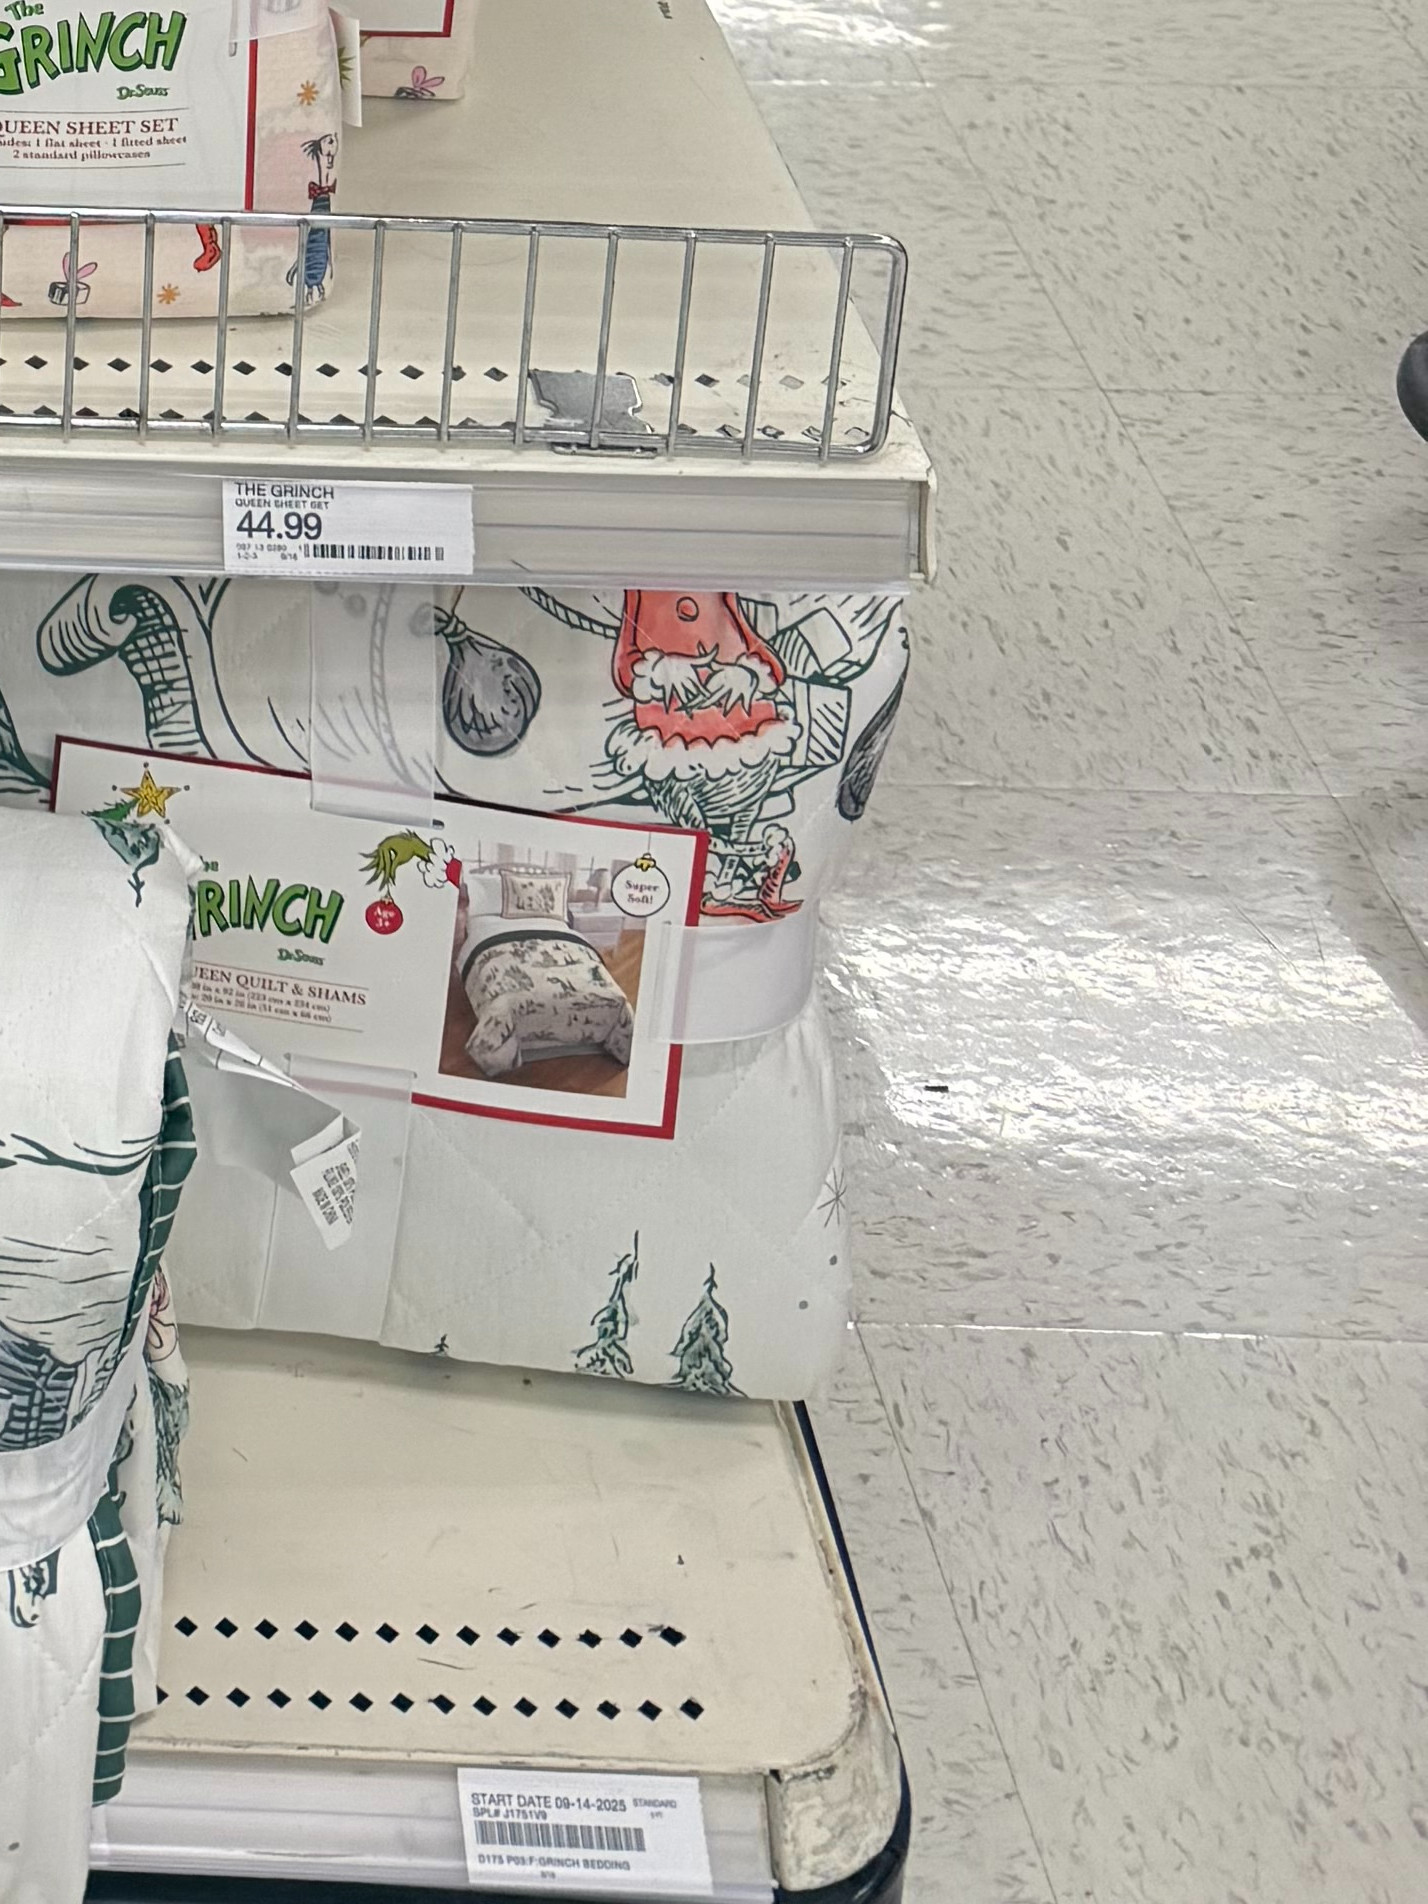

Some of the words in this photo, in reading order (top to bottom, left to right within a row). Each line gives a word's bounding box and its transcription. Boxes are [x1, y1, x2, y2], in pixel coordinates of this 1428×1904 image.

[4, 0, 44, 21] The
[66, 121, 135, 134] SHEET
[140, 118, 178, 133] SET
[69, 138, 101, 148] sheet
[157, 136, 187, 145] sheet
[14, 150, 19, 158] 2
[23, 151, 77, 159] standard
[81, 150, 150, 162] pillowcases
[234, 482, 267, 496] THE
[271, 484, 334, 500] GRINCH
[235, 498, 272, 509] QUEEN
[274, 500, 307, 509] SHEET
[310, 501, 328, 510] SET
[236, 510, 323, 540] 44.99
[624, 880, 659, 897] Super
[188, 875, 345, 944] RINCH
[374, 909, 395, 918] Age
[236, 974, 288, 992] QUILT
[292, 984, 303, 995] &
[308, 986, 366, 1005] SHAMS
[472, 1793, 513, 1806] START
[517, 1795, 552, 1808] DATE
[555, 1797, 626, 1811] 09-14-2025
[583, 1860, 630, 1870] BEDDING
